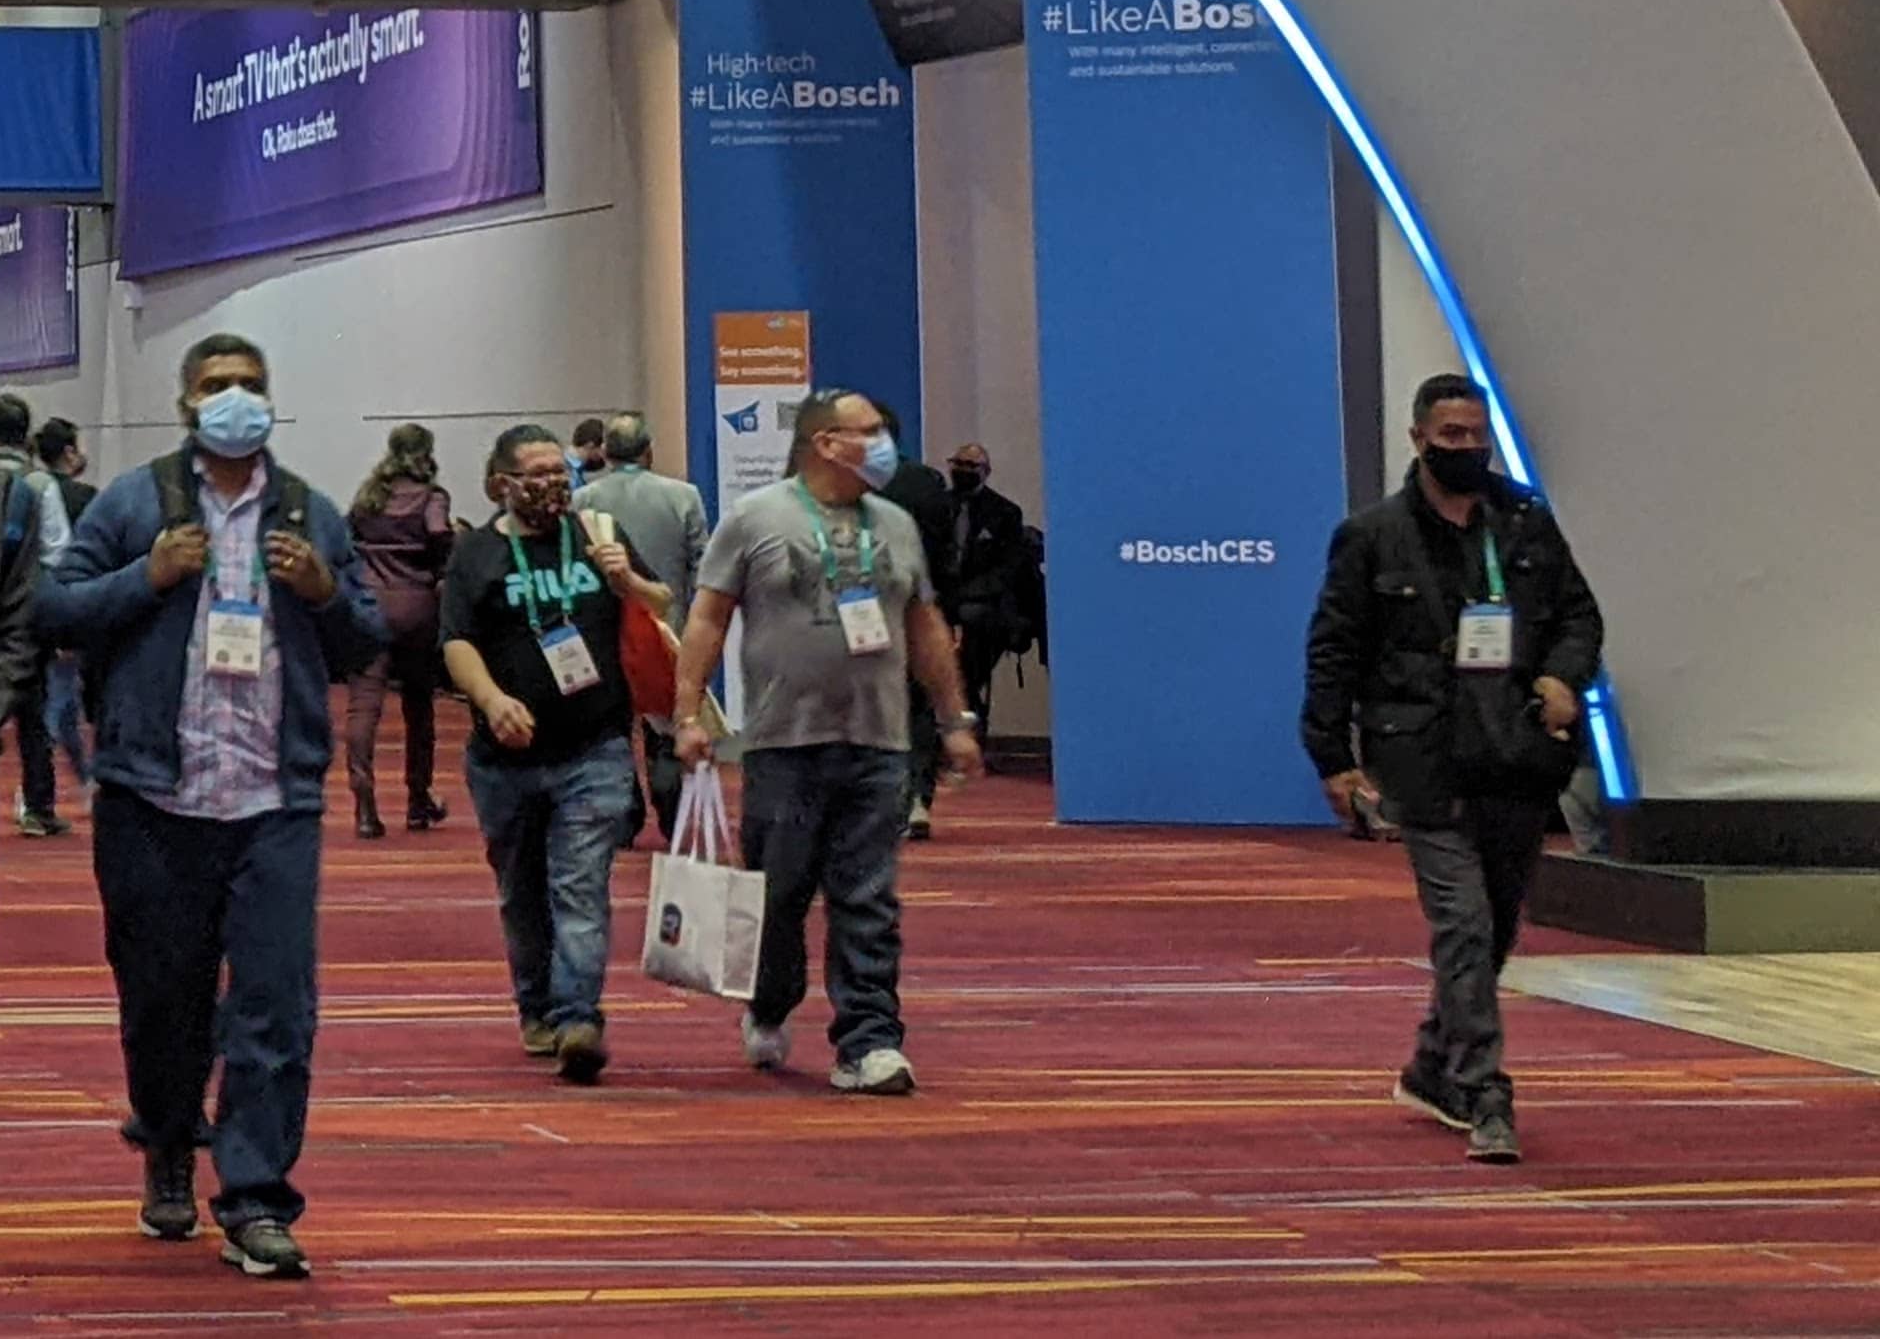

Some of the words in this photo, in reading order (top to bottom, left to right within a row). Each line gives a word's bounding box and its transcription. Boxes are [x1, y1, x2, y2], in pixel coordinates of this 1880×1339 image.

[193, 72, 205, 123] A
[205, 63, 244, 120] smart
[244, 52, 265, 107] TV
[265, 35, 307, 99] that's
[308, 13, 370, 85] actually
[371, 9, 425, 64] smart.
[706, 52, 817, 79] High-tech
[689, 76, 901, 111] #LikeABosch
[1119, 539, 1276, 563] #BoschCES
[503, 561, 601, 607] FILA
